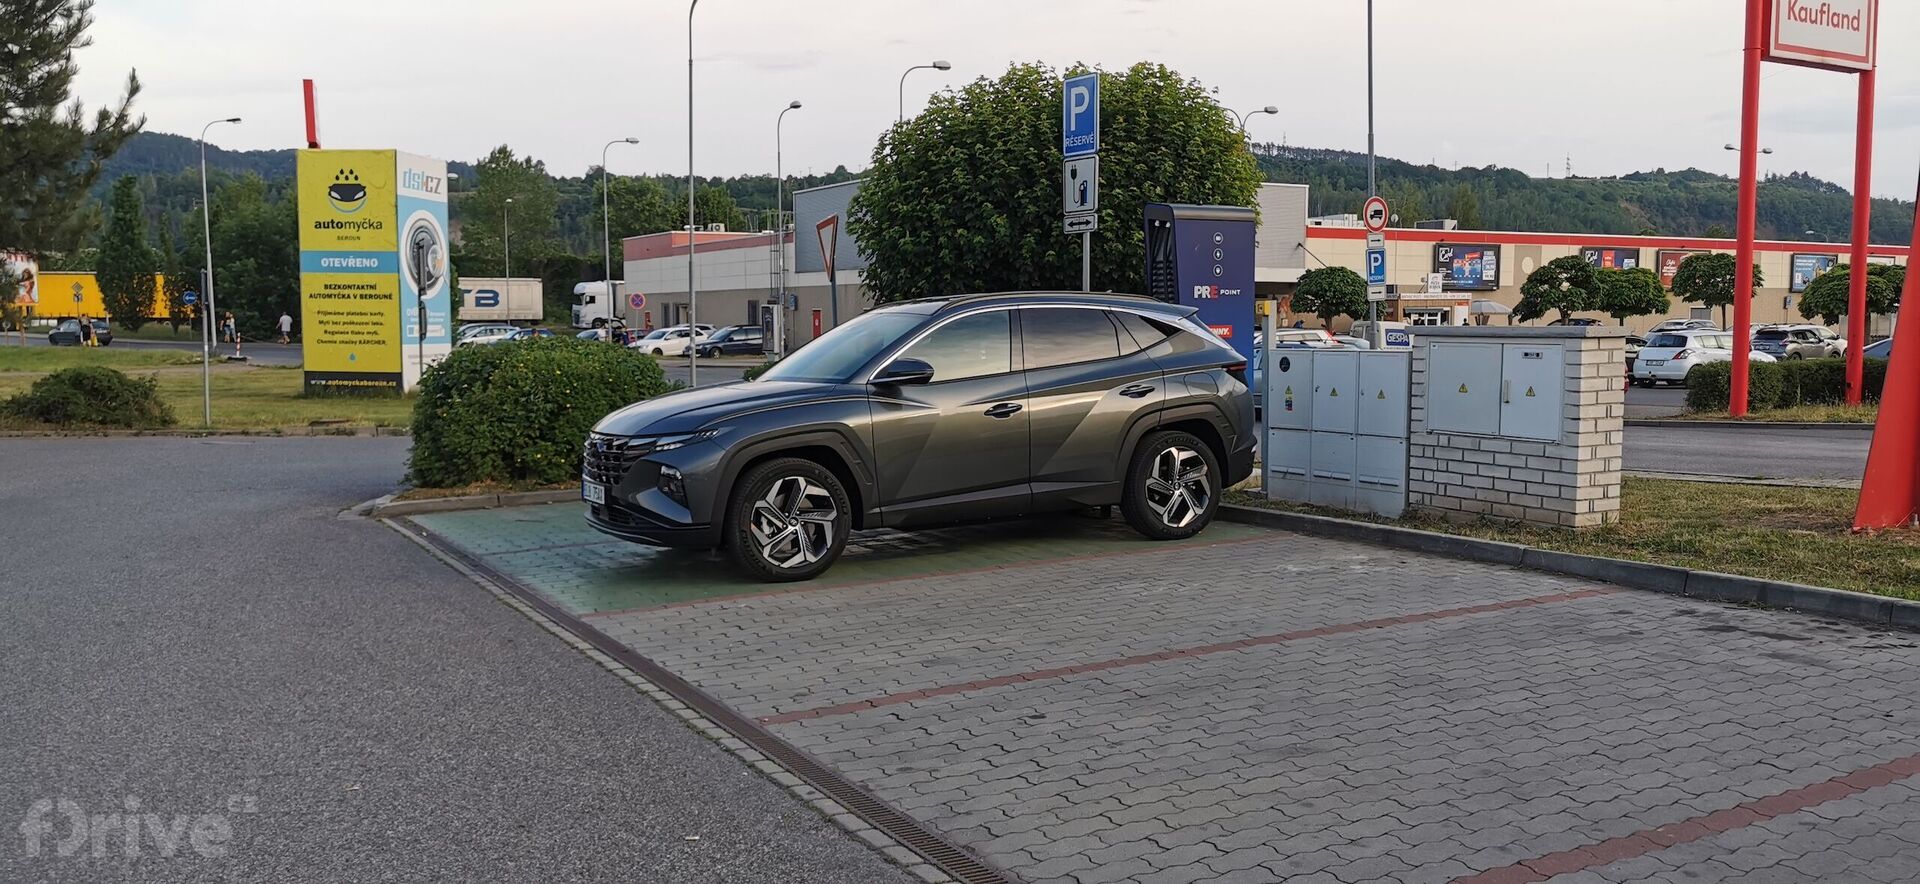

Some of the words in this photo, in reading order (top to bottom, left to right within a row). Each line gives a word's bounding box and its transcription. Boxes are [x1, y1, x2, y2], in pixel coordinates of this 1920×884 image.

[1787, 0, 1861, 32] Kaufland
[1070, 86, 1090, 132] P
[314, 218, 383, 232] automyčka
[320, 255, 379, 268] OTEVŘENO
[1370, 253, 1382, 274] P
[323, 283, 377, 291] BEZKONTAKTNÍ
[1193, 285, 1219, 299] PRE
[308, 292, 351, 300] AUTOMYČKA
[1386, 332, 1409, 343] GESPA
